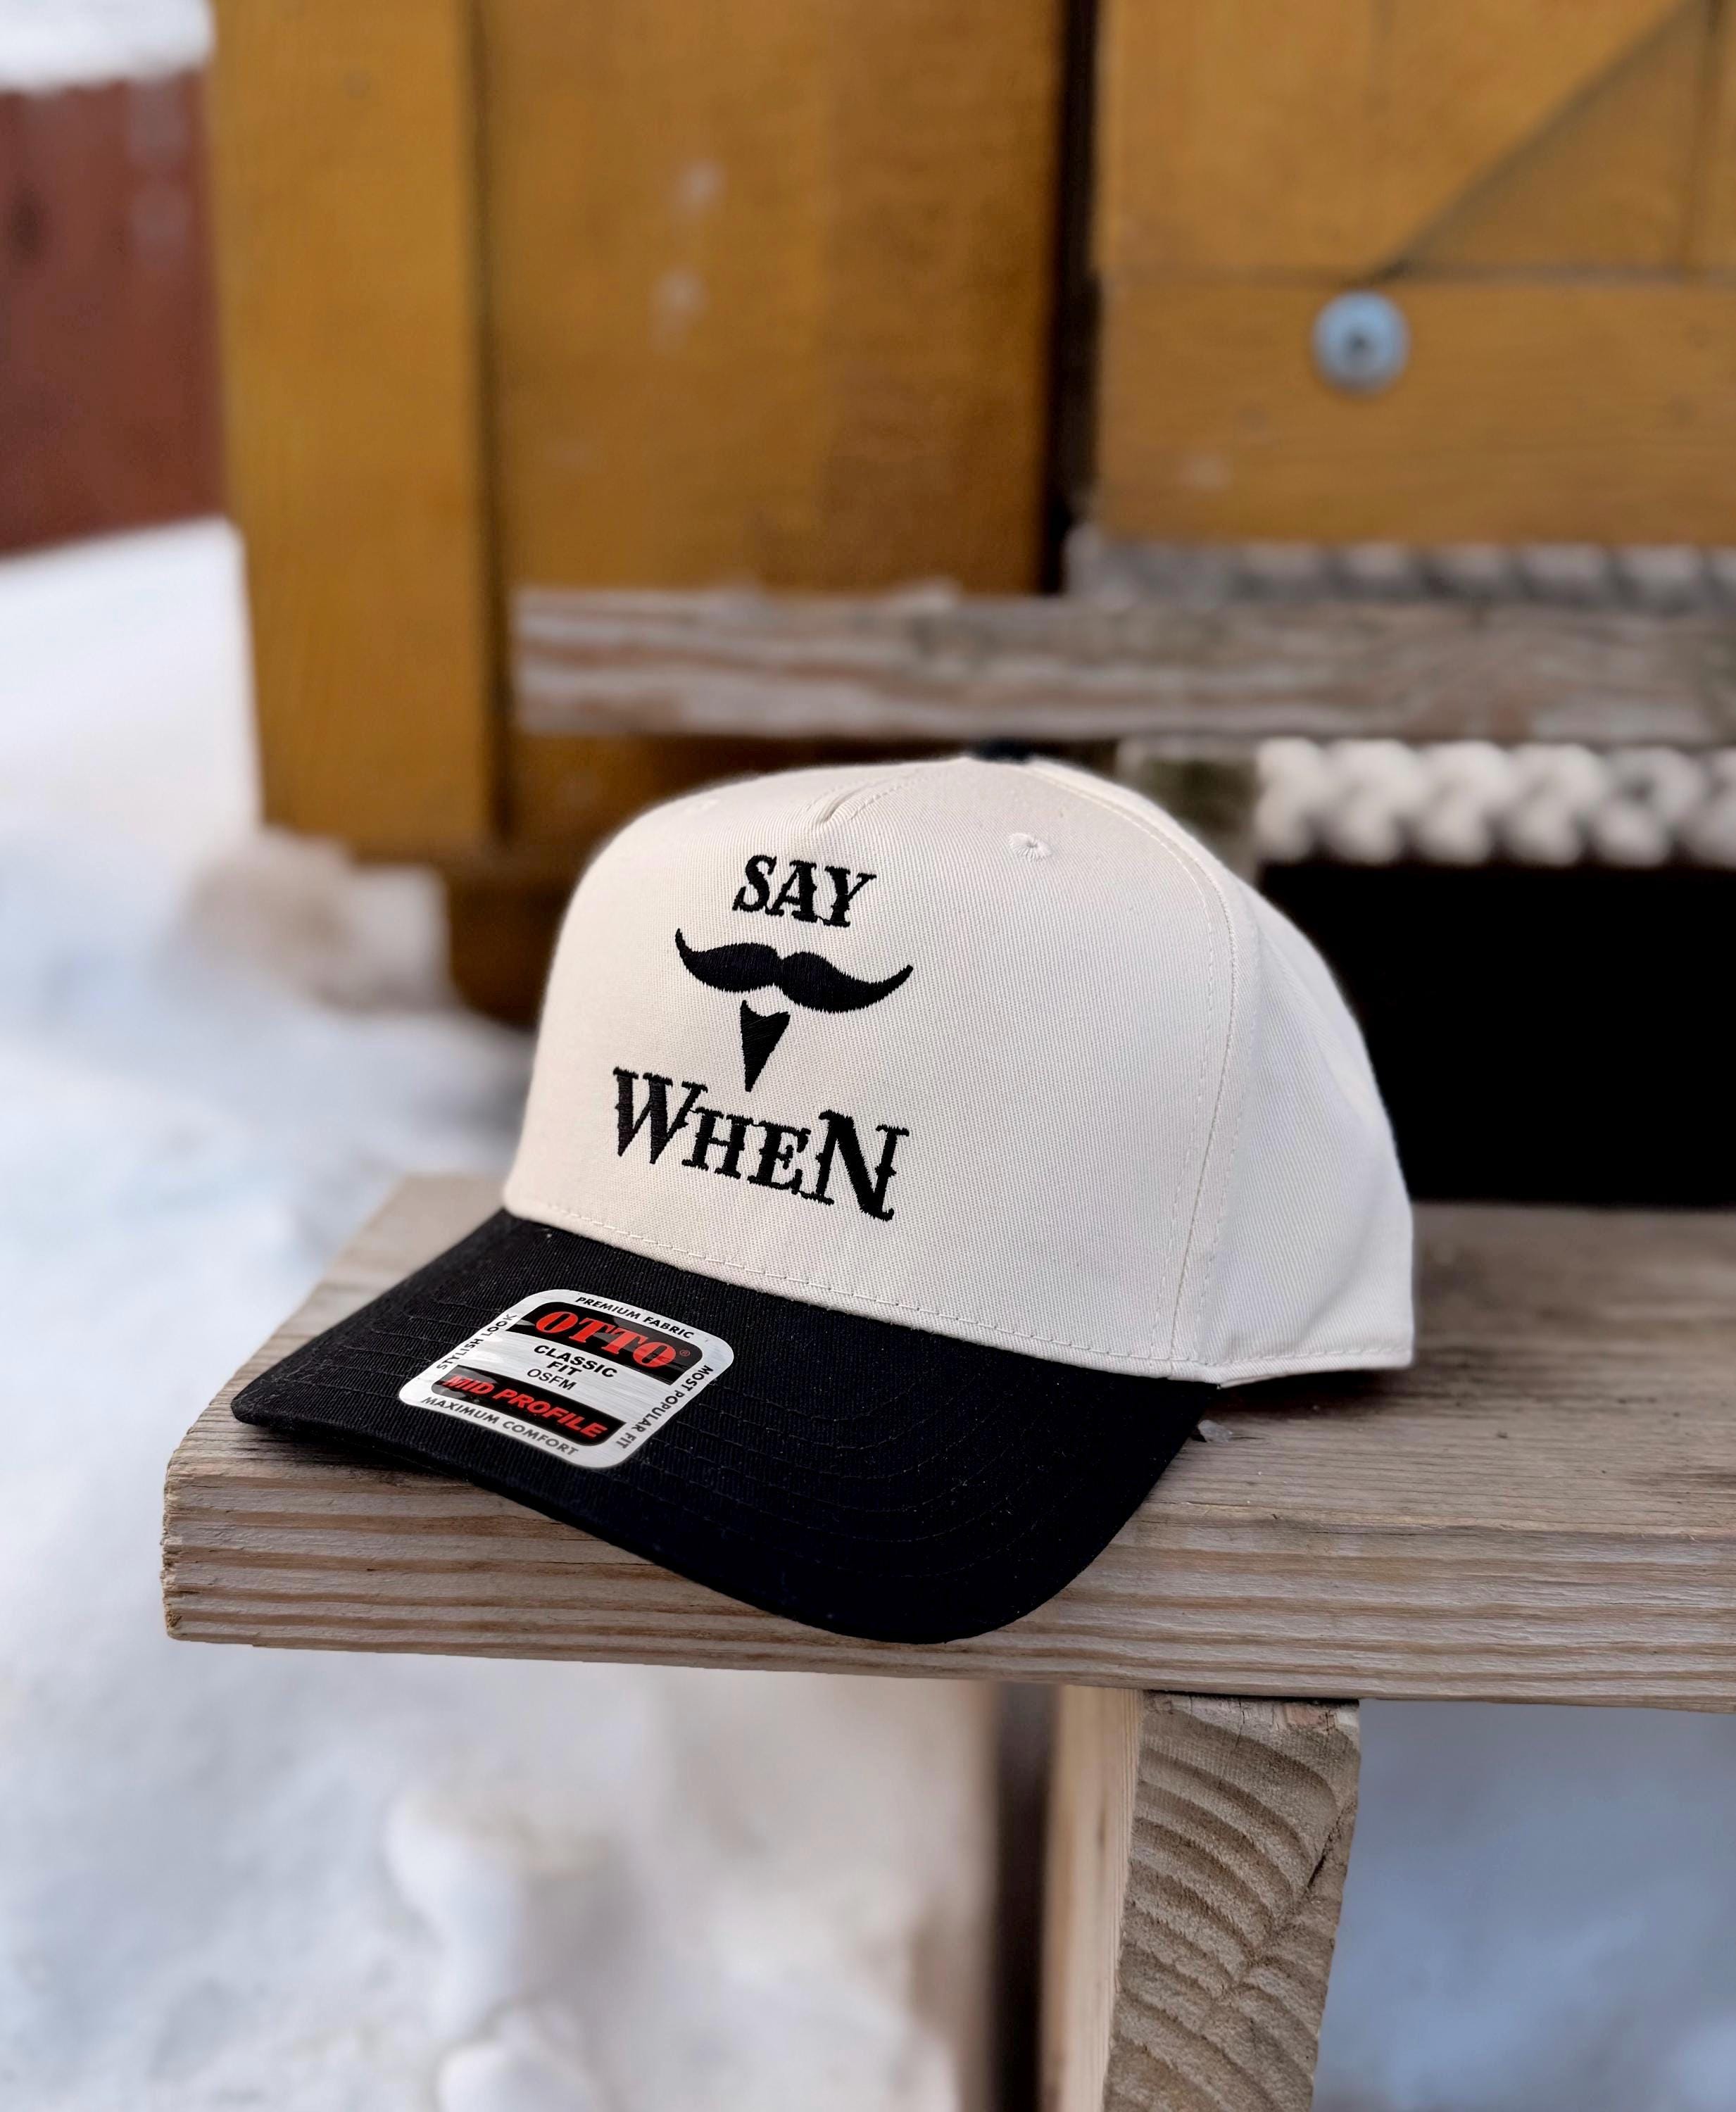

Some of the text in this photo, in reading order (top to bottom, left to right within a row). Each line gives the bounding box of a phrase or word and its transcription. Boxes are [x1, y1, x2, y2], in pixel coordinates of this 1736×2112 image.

[732, 854, 876, 927] SAY
[436, 1313, 518, 1370] STYLISH LOOK
[575, 1296, 695, 1339] PREMIUM FABRIC
[527, 1368, 577, 1390] OSFM
[534, 1344, 617, 1378] CLASSIC
[546, 1357, 585, 1376] FIT
[421, 1396, 579, 1456] MAXIMUM COMFORT
[442, 1375, 608, 1438] MID PROFILE
[616, 1365, 714, 1449] MOST POPULAR FIT
